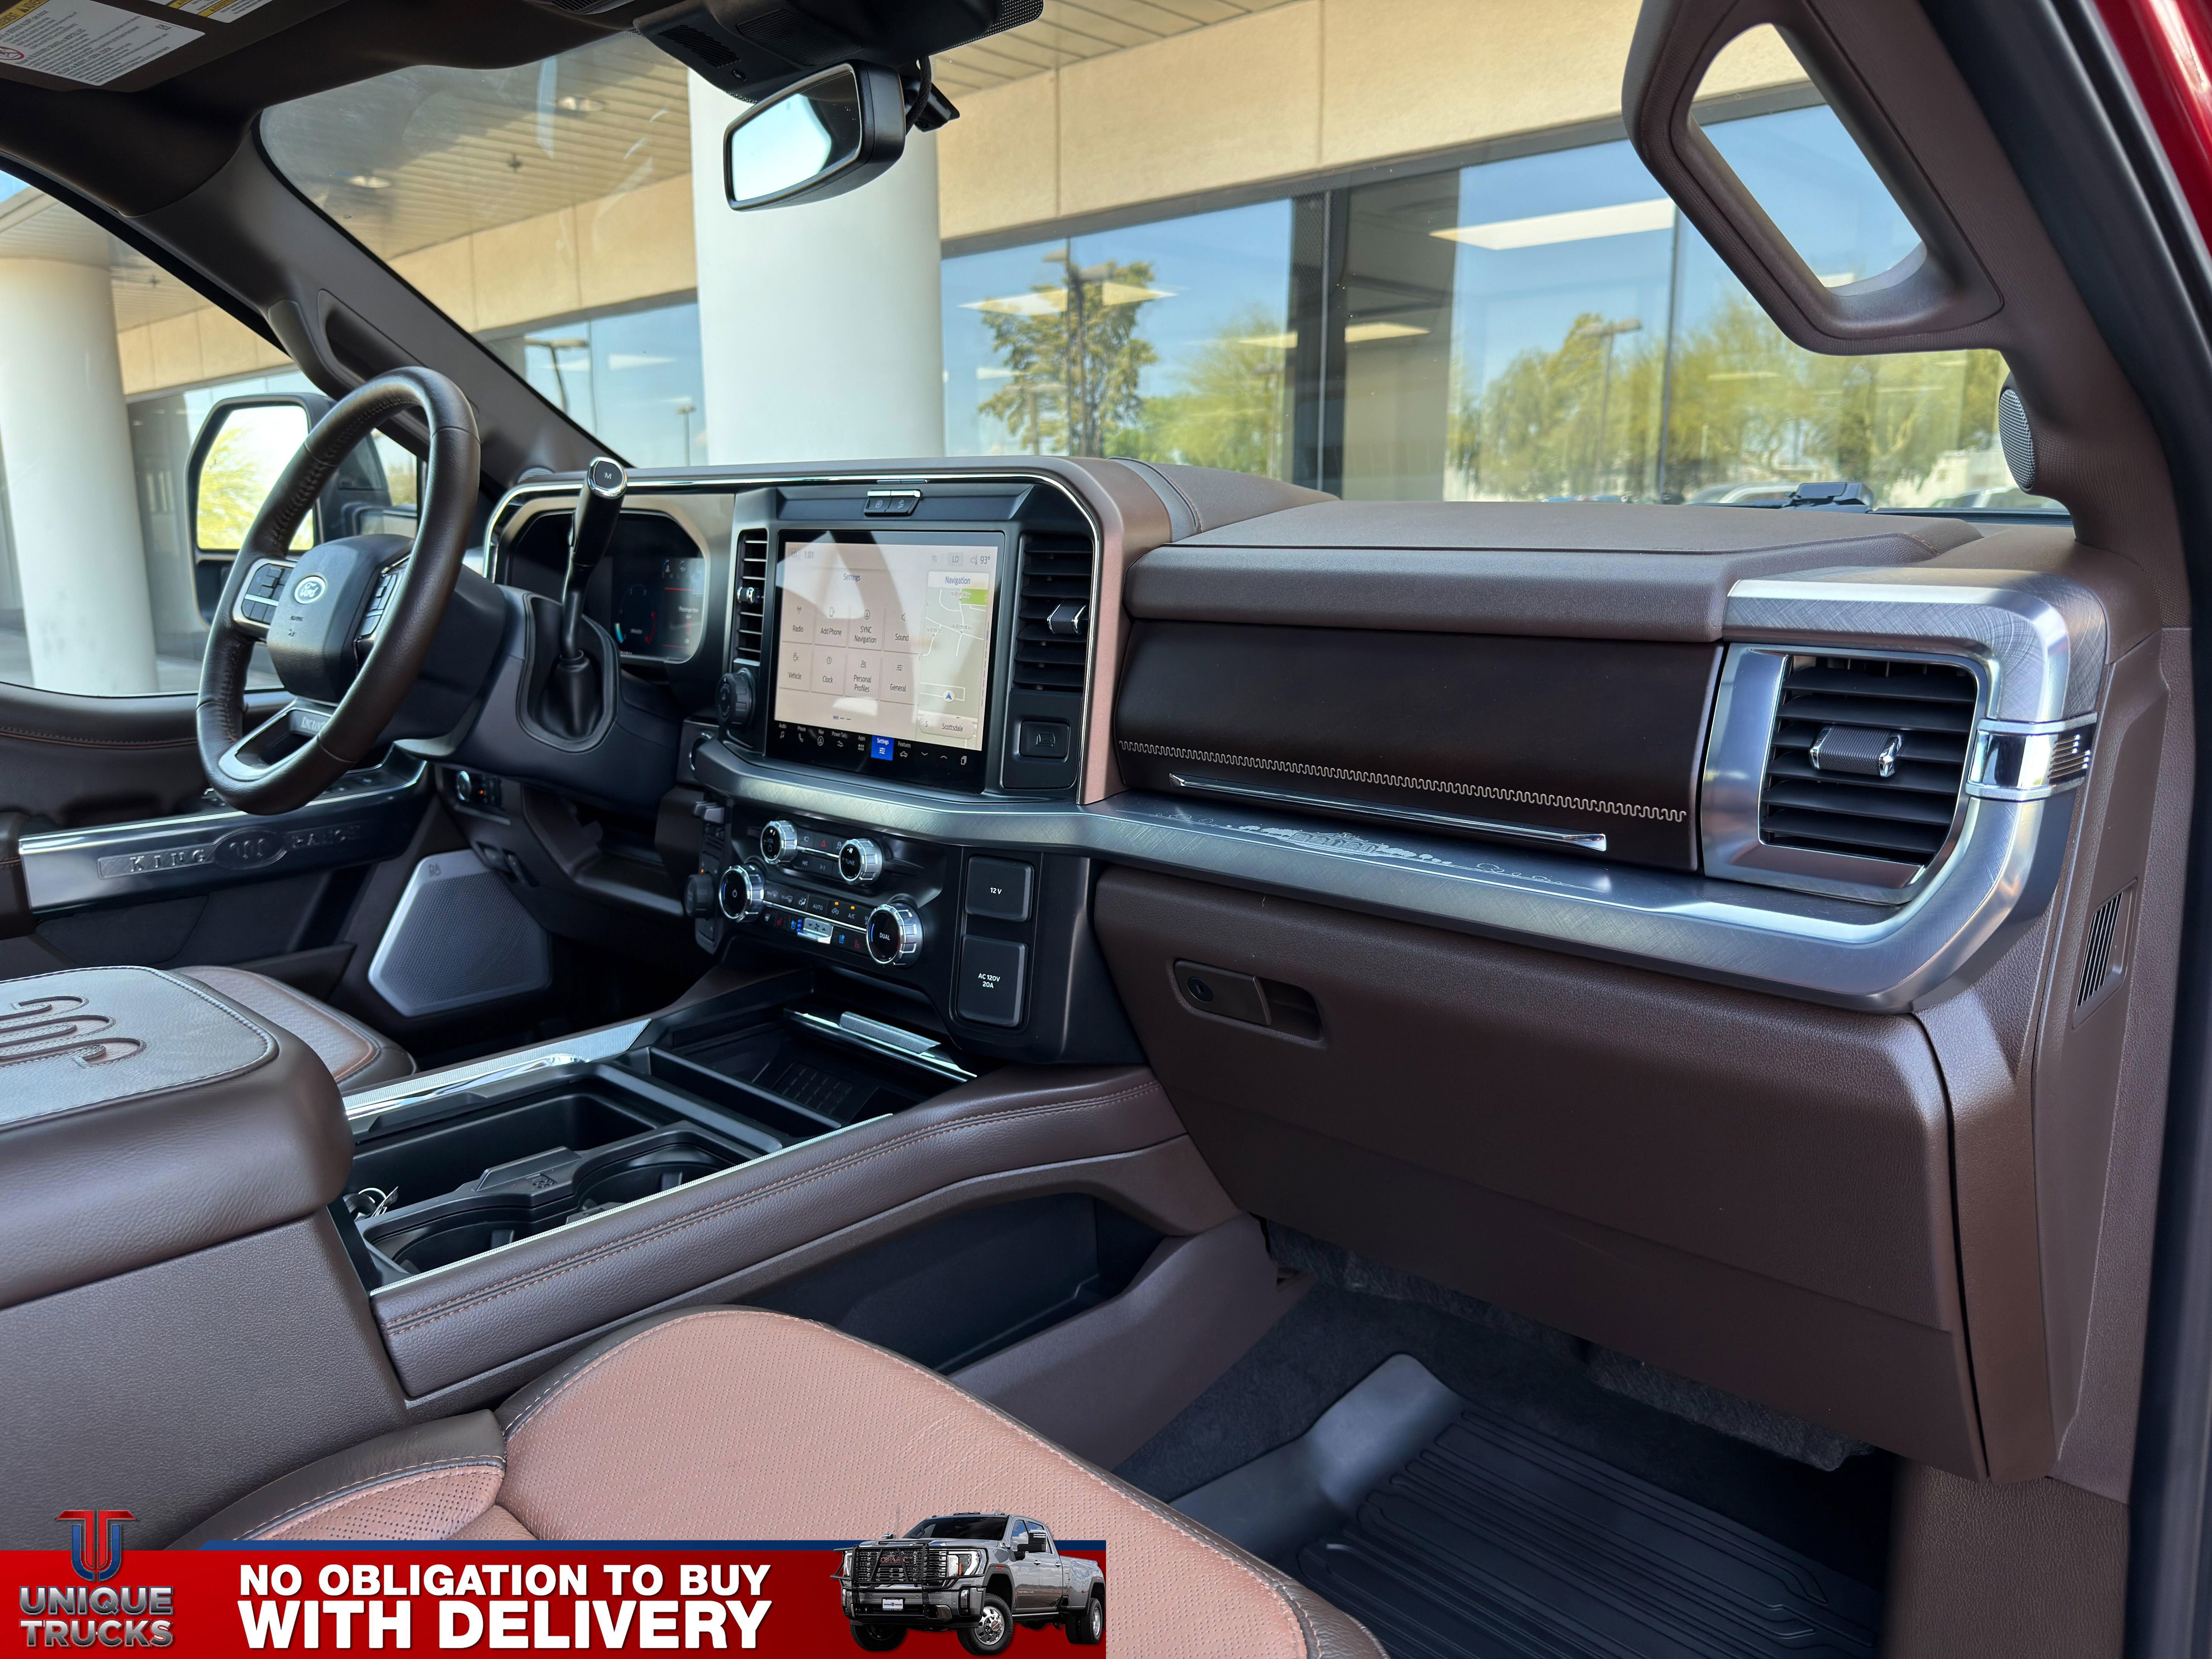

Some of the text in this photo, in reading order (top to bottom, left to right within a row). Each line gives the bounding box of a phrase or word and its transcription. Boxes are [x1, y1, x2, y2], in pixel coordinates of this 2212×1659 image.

[980, 556, 990, 564] 93°
[844, 573, 861, 582] Settings
[945, 576, 970, 585] Navigation
[300, 582, 319, 598] Ford
[860, 626, 872, 634] SYNC
[854, 635, 877, 644] Navigation
[895, 633, 909, 641] Sound
[854, 675, 871, 683] Personal
[854, 684, 869, 692] Profiles
[890, 684, 906, 692] General
[942, 723, 963, 732] Scottsdale
[129, 849, 205, 873] KING
